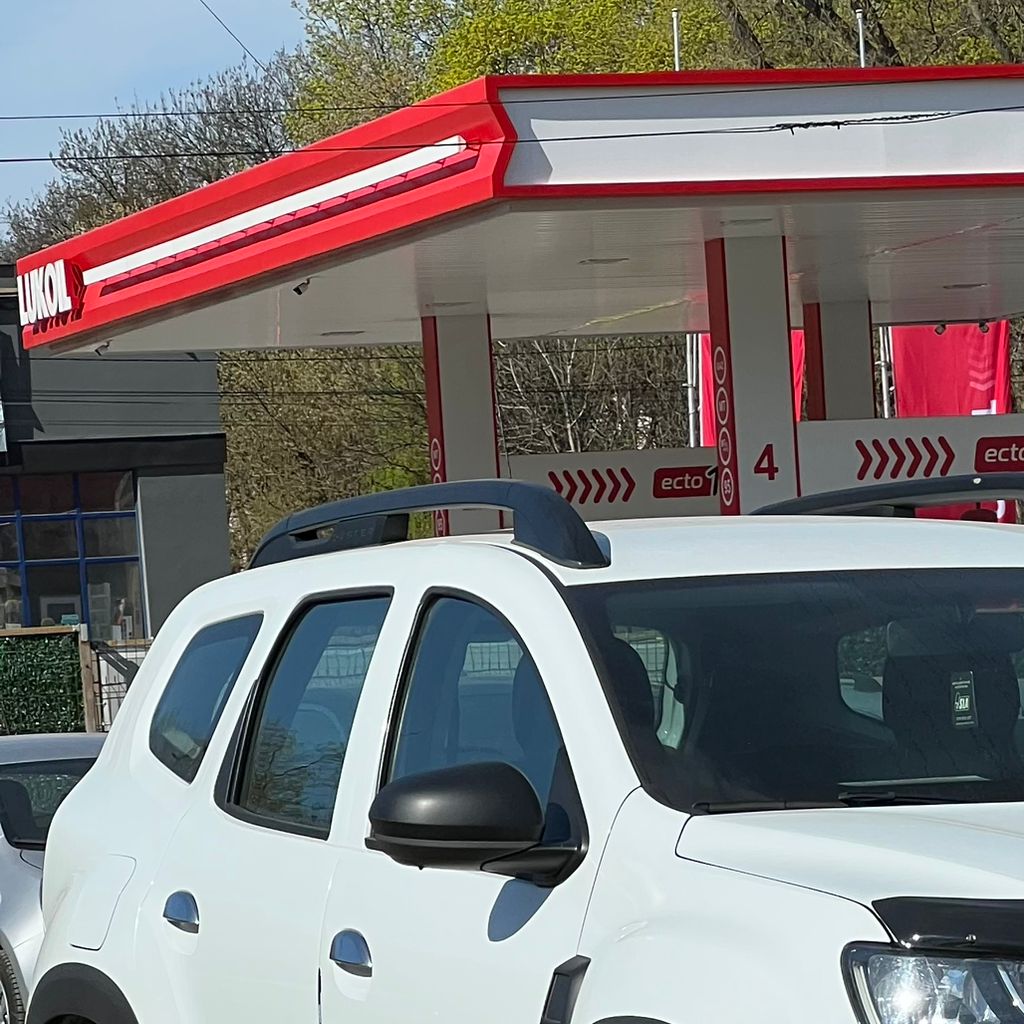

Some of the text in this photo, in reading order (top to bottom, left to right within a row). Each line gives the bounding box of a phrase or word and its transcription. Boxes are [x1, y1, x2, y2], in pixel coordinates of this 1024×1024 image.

[17, 259, 72, 326] LUKOIL
[754, 444, 779, 480] 4
[661, 465, 718, 496] ecto1
